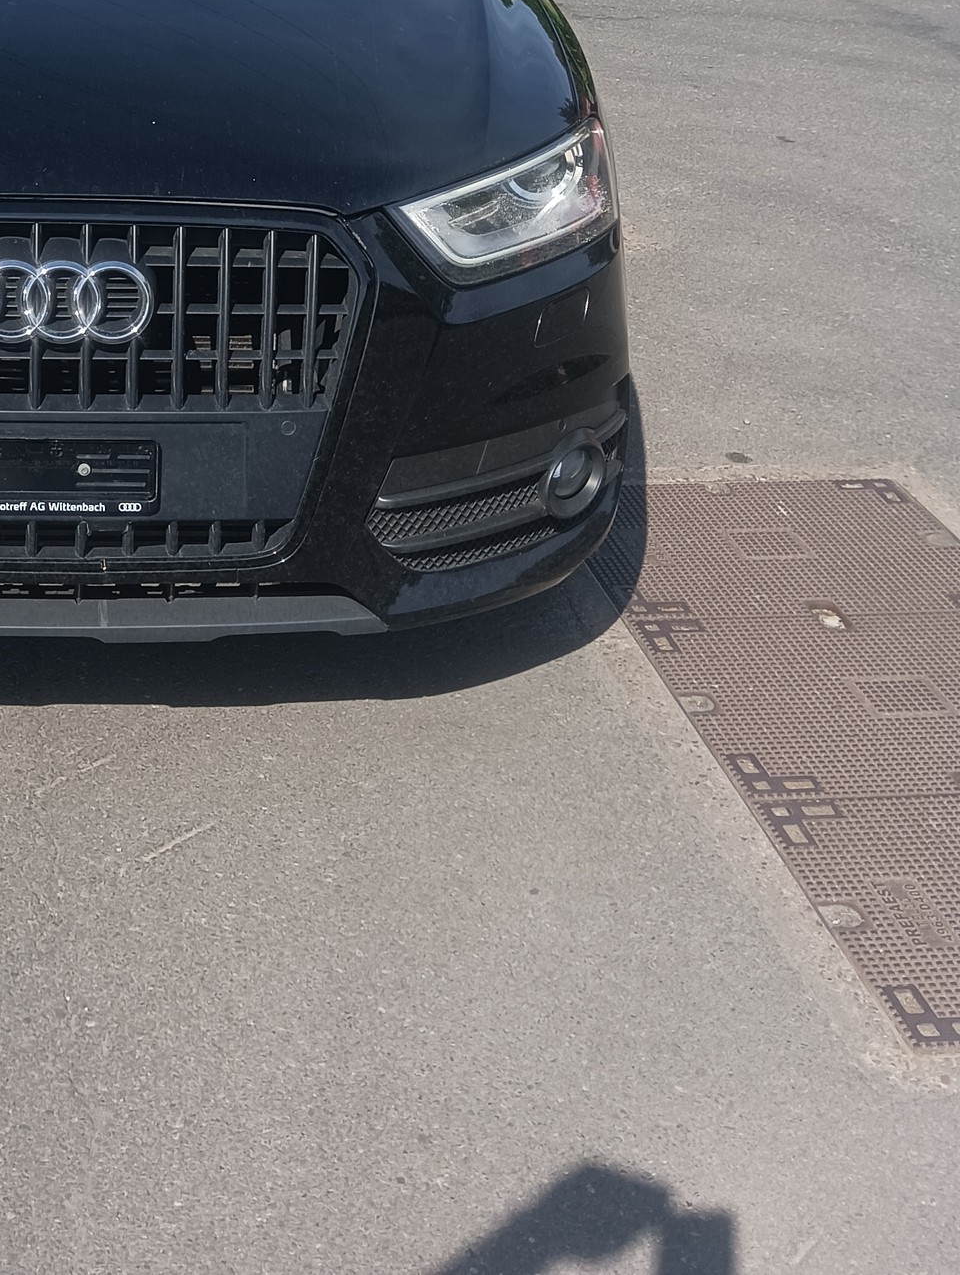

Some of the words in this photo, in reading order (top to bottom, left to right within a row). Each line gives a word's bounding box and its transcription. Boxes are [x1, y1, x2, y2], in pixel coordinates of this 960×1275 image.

[29, 501, 46, 512] AG
[48, 502, 106, 512] Wittenbach
[870, 881, 928, 946] PREFAEST
